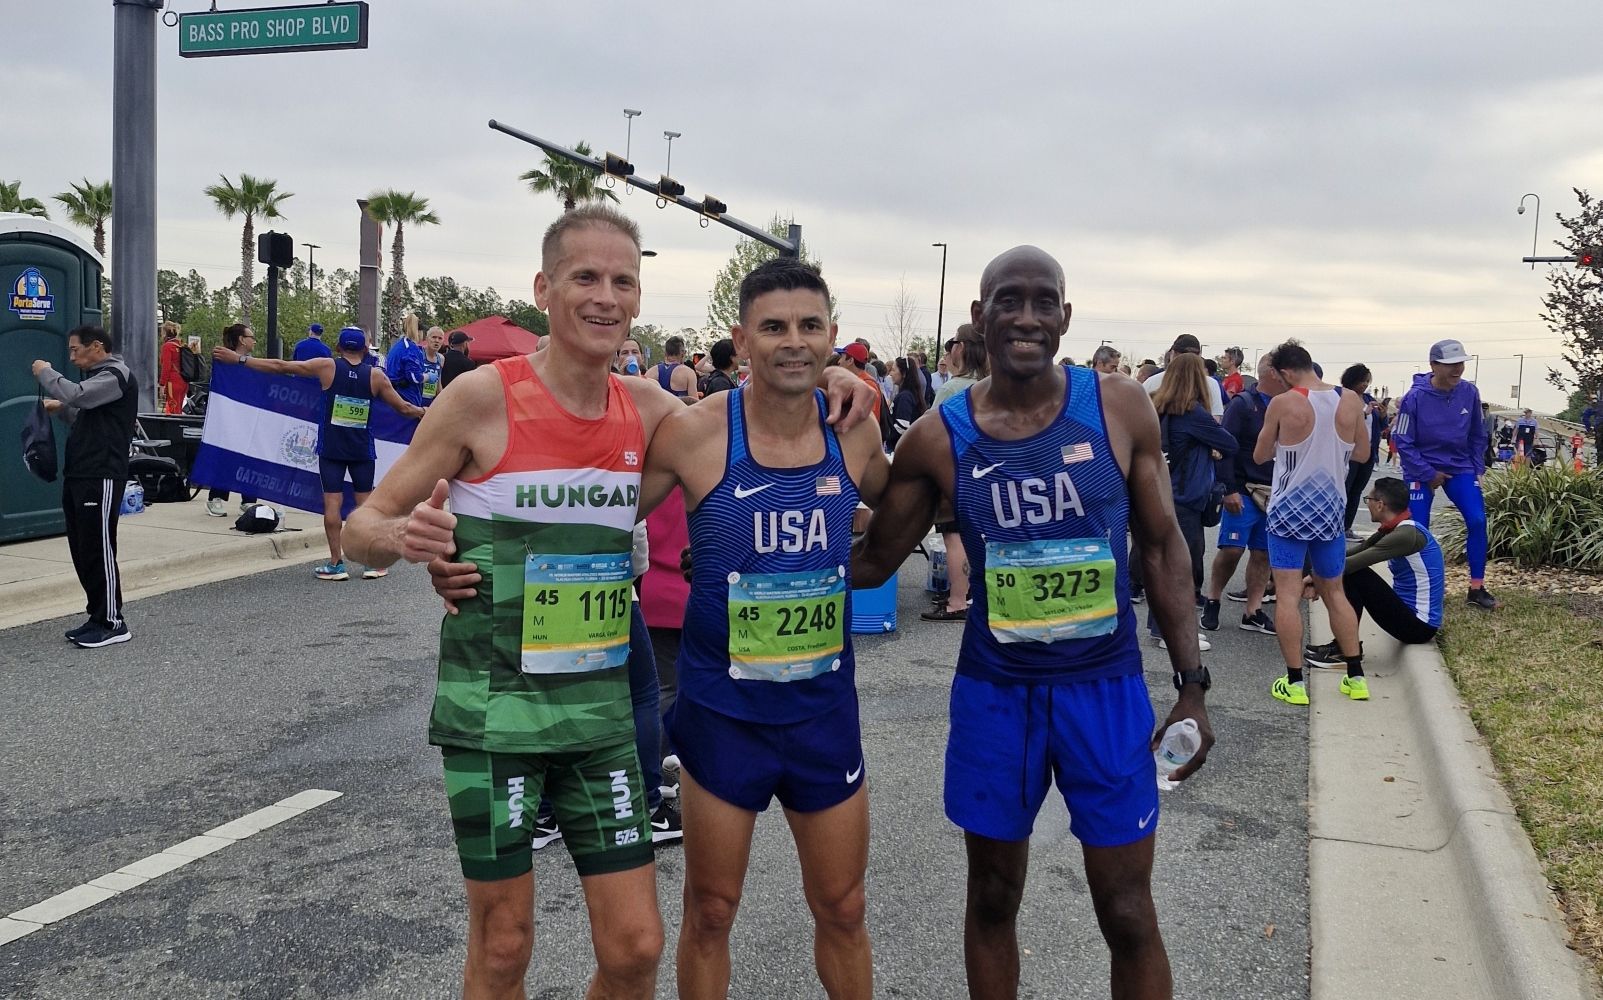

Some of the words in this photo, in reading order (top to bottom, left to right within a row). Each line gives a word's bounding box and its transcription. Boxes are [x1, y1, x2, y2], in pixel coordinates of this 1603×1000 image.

[189, 22, 224, 42] BASS
[231, 20, 259, 40] PRO
[266, 17, 305, 38] SHOP
[312, 14, 350, 35] BLVD
[13, 296, 51, 308] PortaServe
[349, 405, 364, 416] 599
[516, 483, 639, 508] HUNGAR
[991, 471, 1085, 528] USA
[754, 508, 828, 554] USA
[996, 573, 1016, 588] 50
[1031, 568, 1100, 602] 3273
[535, 589, 559, 605] 45
[579, 587, 627, 622] 1115
[738, 607, 760, 621] 45
[776, 601, 836, 636] 2248
[533, 615, 544, 626] M
[738, 629, 748, 639] M
[507, 776, 525, 828] HUN
[609, 769, 634, 820] HUN
[614, 826, 640, 846] 575
